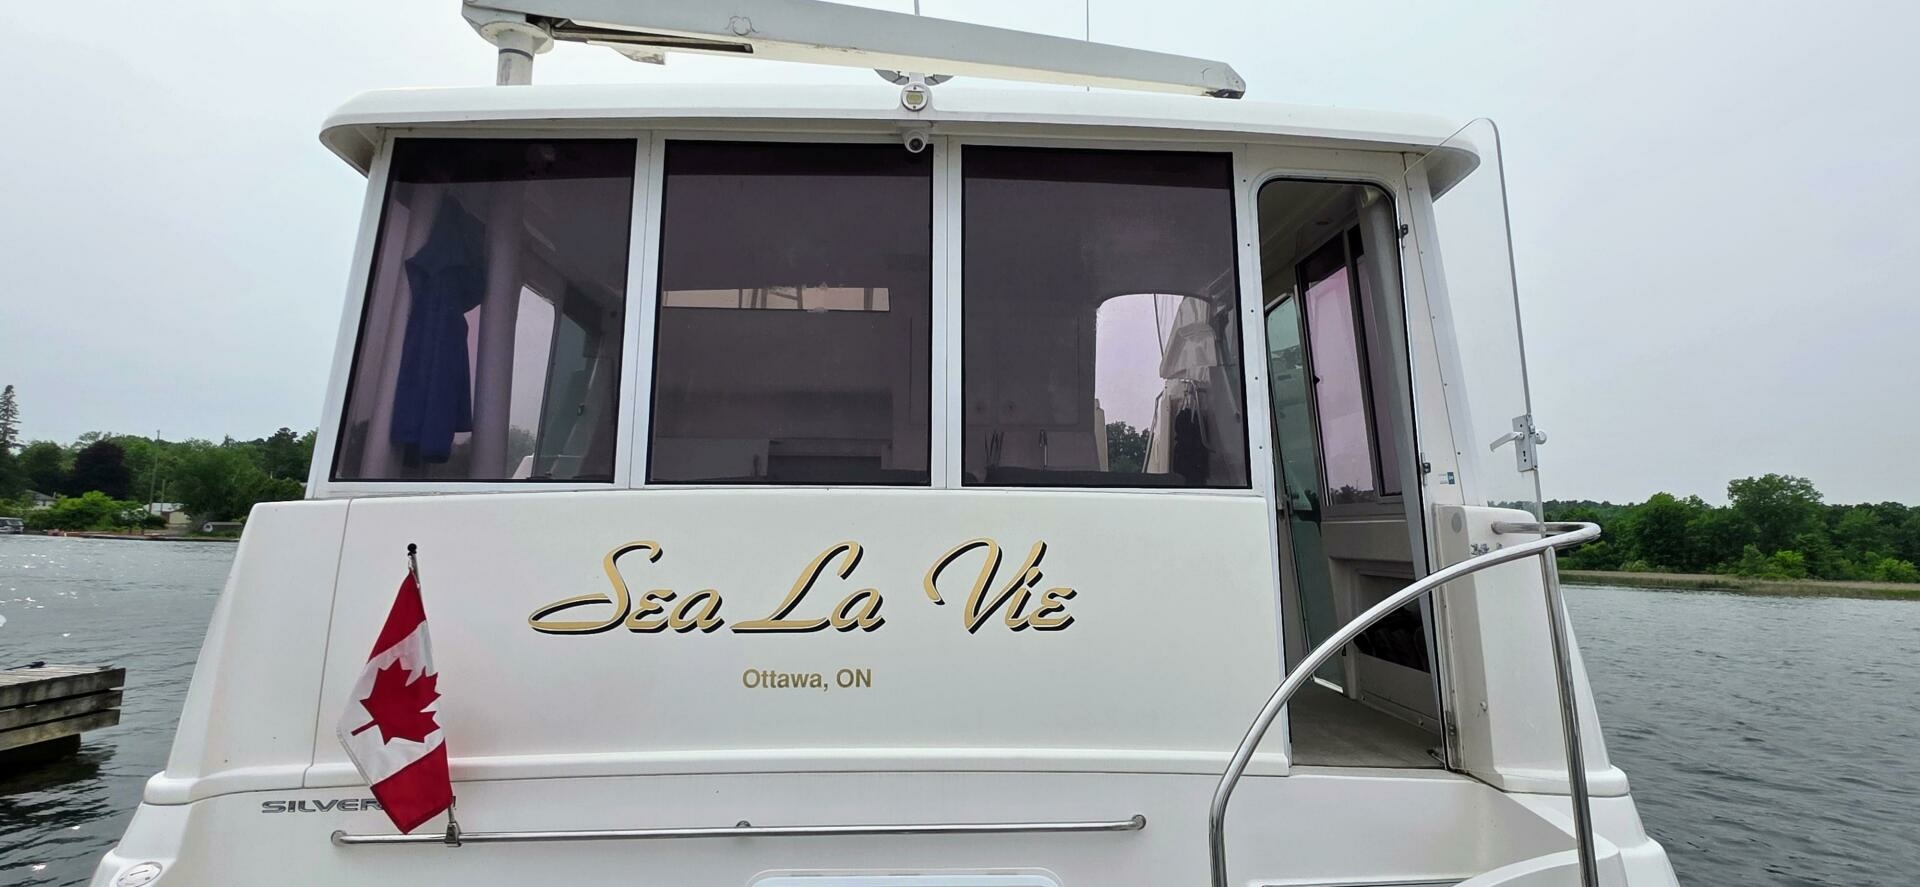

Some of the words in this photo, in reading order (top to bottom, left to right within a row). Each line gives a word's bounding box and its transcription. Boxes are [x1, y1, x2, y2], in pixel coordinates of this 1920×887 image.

[528, 540, 725, 634] Sea
[729, 541, 886, 634] La
[923, 538, 1078, 635] Vie
[742, 668, 828, 692] Ottawa,
[836, 668, 872, 688] ON
[261, 798, 386, 813] SILVER
